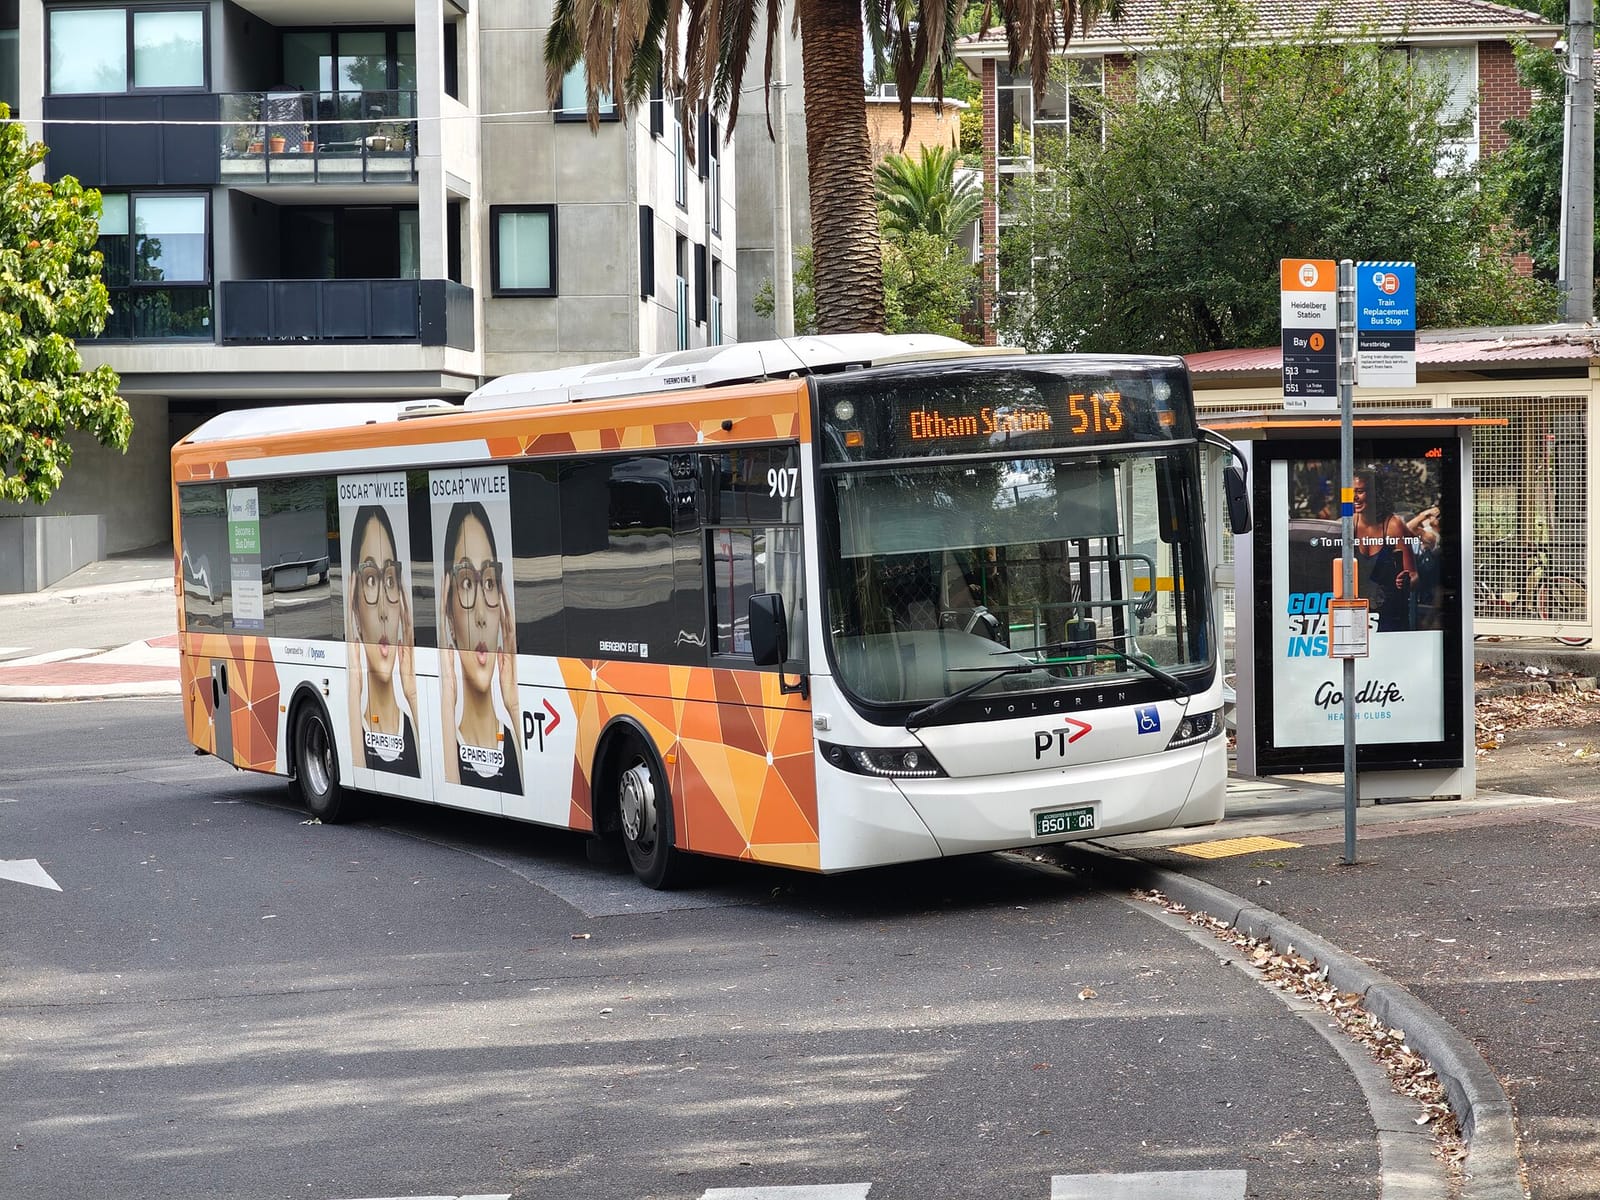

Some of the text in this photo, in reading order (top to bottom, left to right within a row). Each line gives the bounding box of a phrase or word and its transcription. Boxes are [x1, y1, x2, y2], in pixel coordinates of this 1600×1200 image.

[1290, 301, 1327, 311] Heidelberg
[1377, 298, 1395, 306] Train
[1363, 307, 1409, 316] Replacement
[1370, 317, 1402, 326] Bus Stop
[1293, 337, 1319, 348] Bay 1
[1360, 341, 1391, 349] Hurstbridge
[1285, 366, 1299, 376] 513
[1285, 383, 1300, 393] 551
[910, 391, 1124, 439] Eltham Station 513
[432, 475, 506, 496] OSCAR WYLEE
[767, 467, 798, 498] 907
[340, 481, 405, 500] OSCAR WYLEE
[1320, 537, 1332, 547] To
[1334, 538, 1360, 546] me
[1362, 536, 1384, 546] time
[1385, 536, 1400, 545] for
[1288, 592, 1334, 614] GOO
[1289, 613, 1380, 635] STAS
[599, 640, 639, 653] EMERGENCY EXIT
[1314, 680, 1405, 710] Godlife.
[1327, 711, 1392, 721] HEAH CLUBS
[523, 711, 546, 753] PT
[366, 733, 371, 745] 2
[371, 734, 389, 748] PAIRS
[1034, 727, 1070, 760] PT
[461, 746, 467, 759] 2
[467, 747, 487, 763] PAIRS
[1078, 814, 1094, 828] QR
